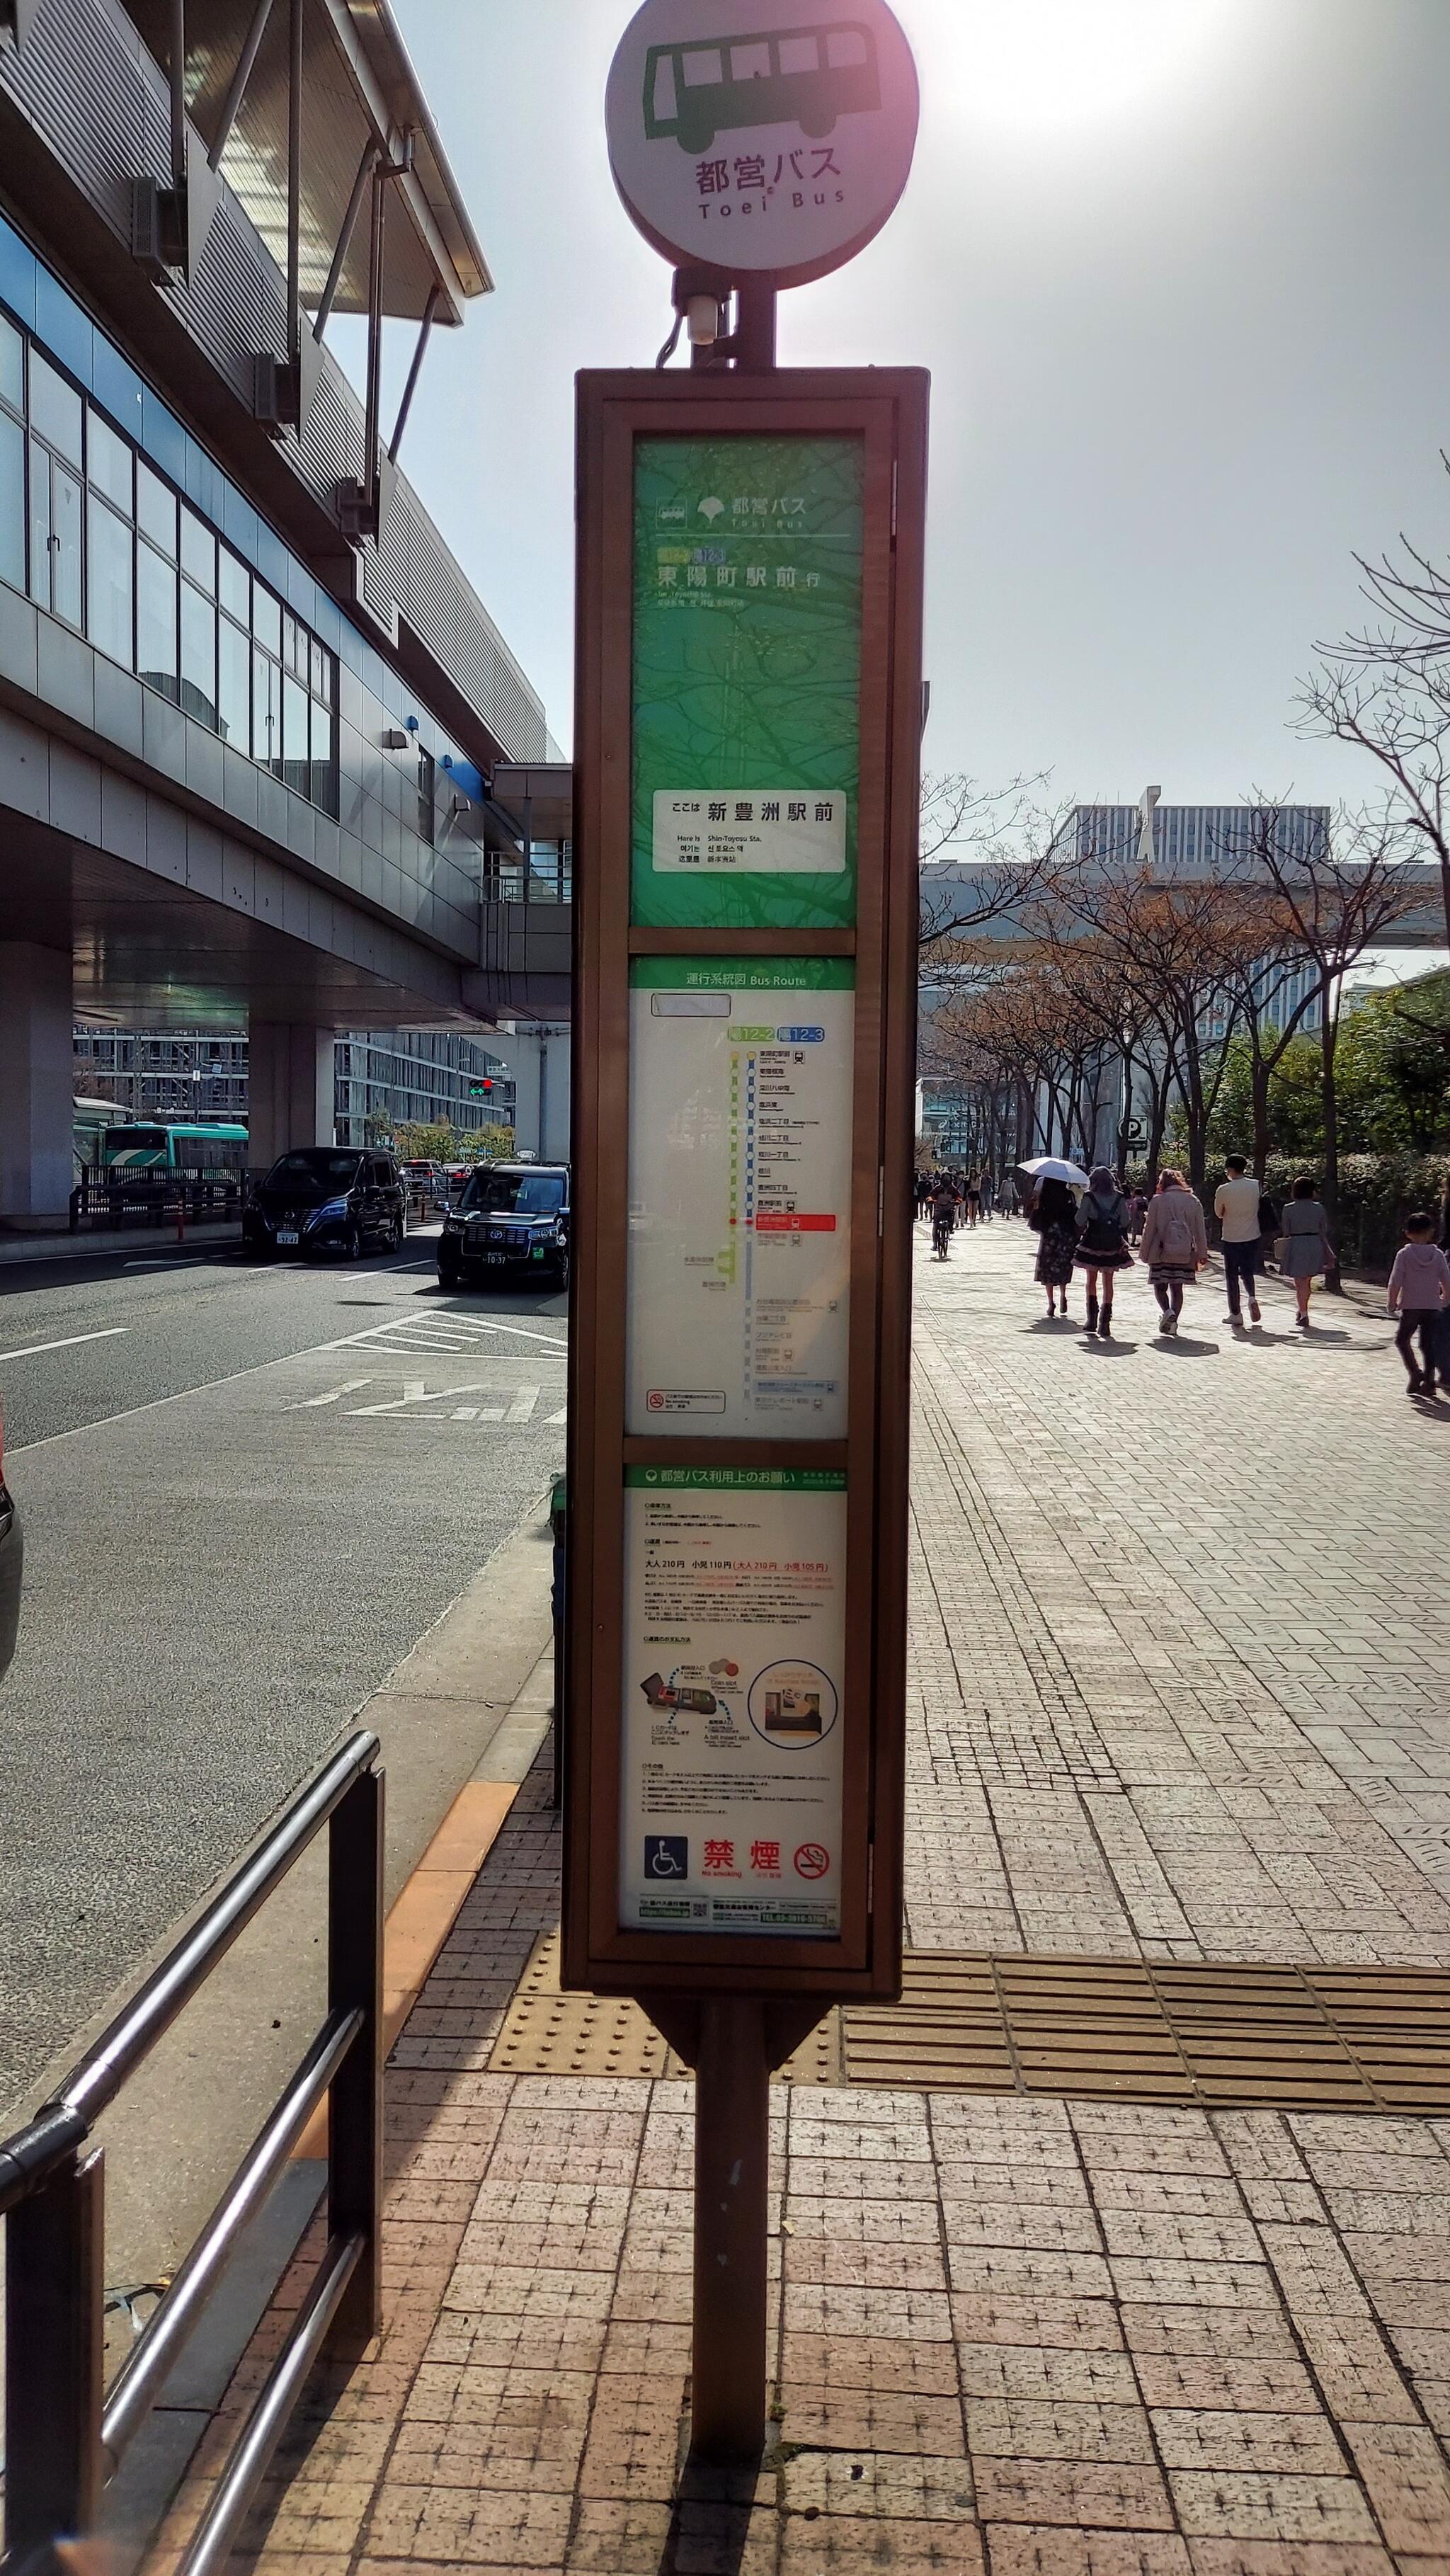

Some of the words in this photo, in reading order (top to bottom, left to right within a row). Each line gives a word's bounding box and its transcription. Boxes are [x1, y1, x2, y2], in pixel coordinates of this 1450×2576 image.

[695, 147, 843, 195] 都営バス
[698, 195, 767, 220] Toei
[792, 189, 845, 208] Bus
[731, 497, 807, 515] 都営バス
[671, 802, 701, 813] ここは
[707, 802, 833, 822] 新豊洲駅前
[685, 972, 746, 986] 運行系統図
[750, 976, 770, 986] Bus
[773, 976, 806, 986] Route
[1128, 1121, 1139, 1138] P
[661, 1469, 795, 1484] 都営バス利用上のお願い
[703, 1839, 781, 1871] 禁煙
[713, 1870, 743, 1879] smoking
